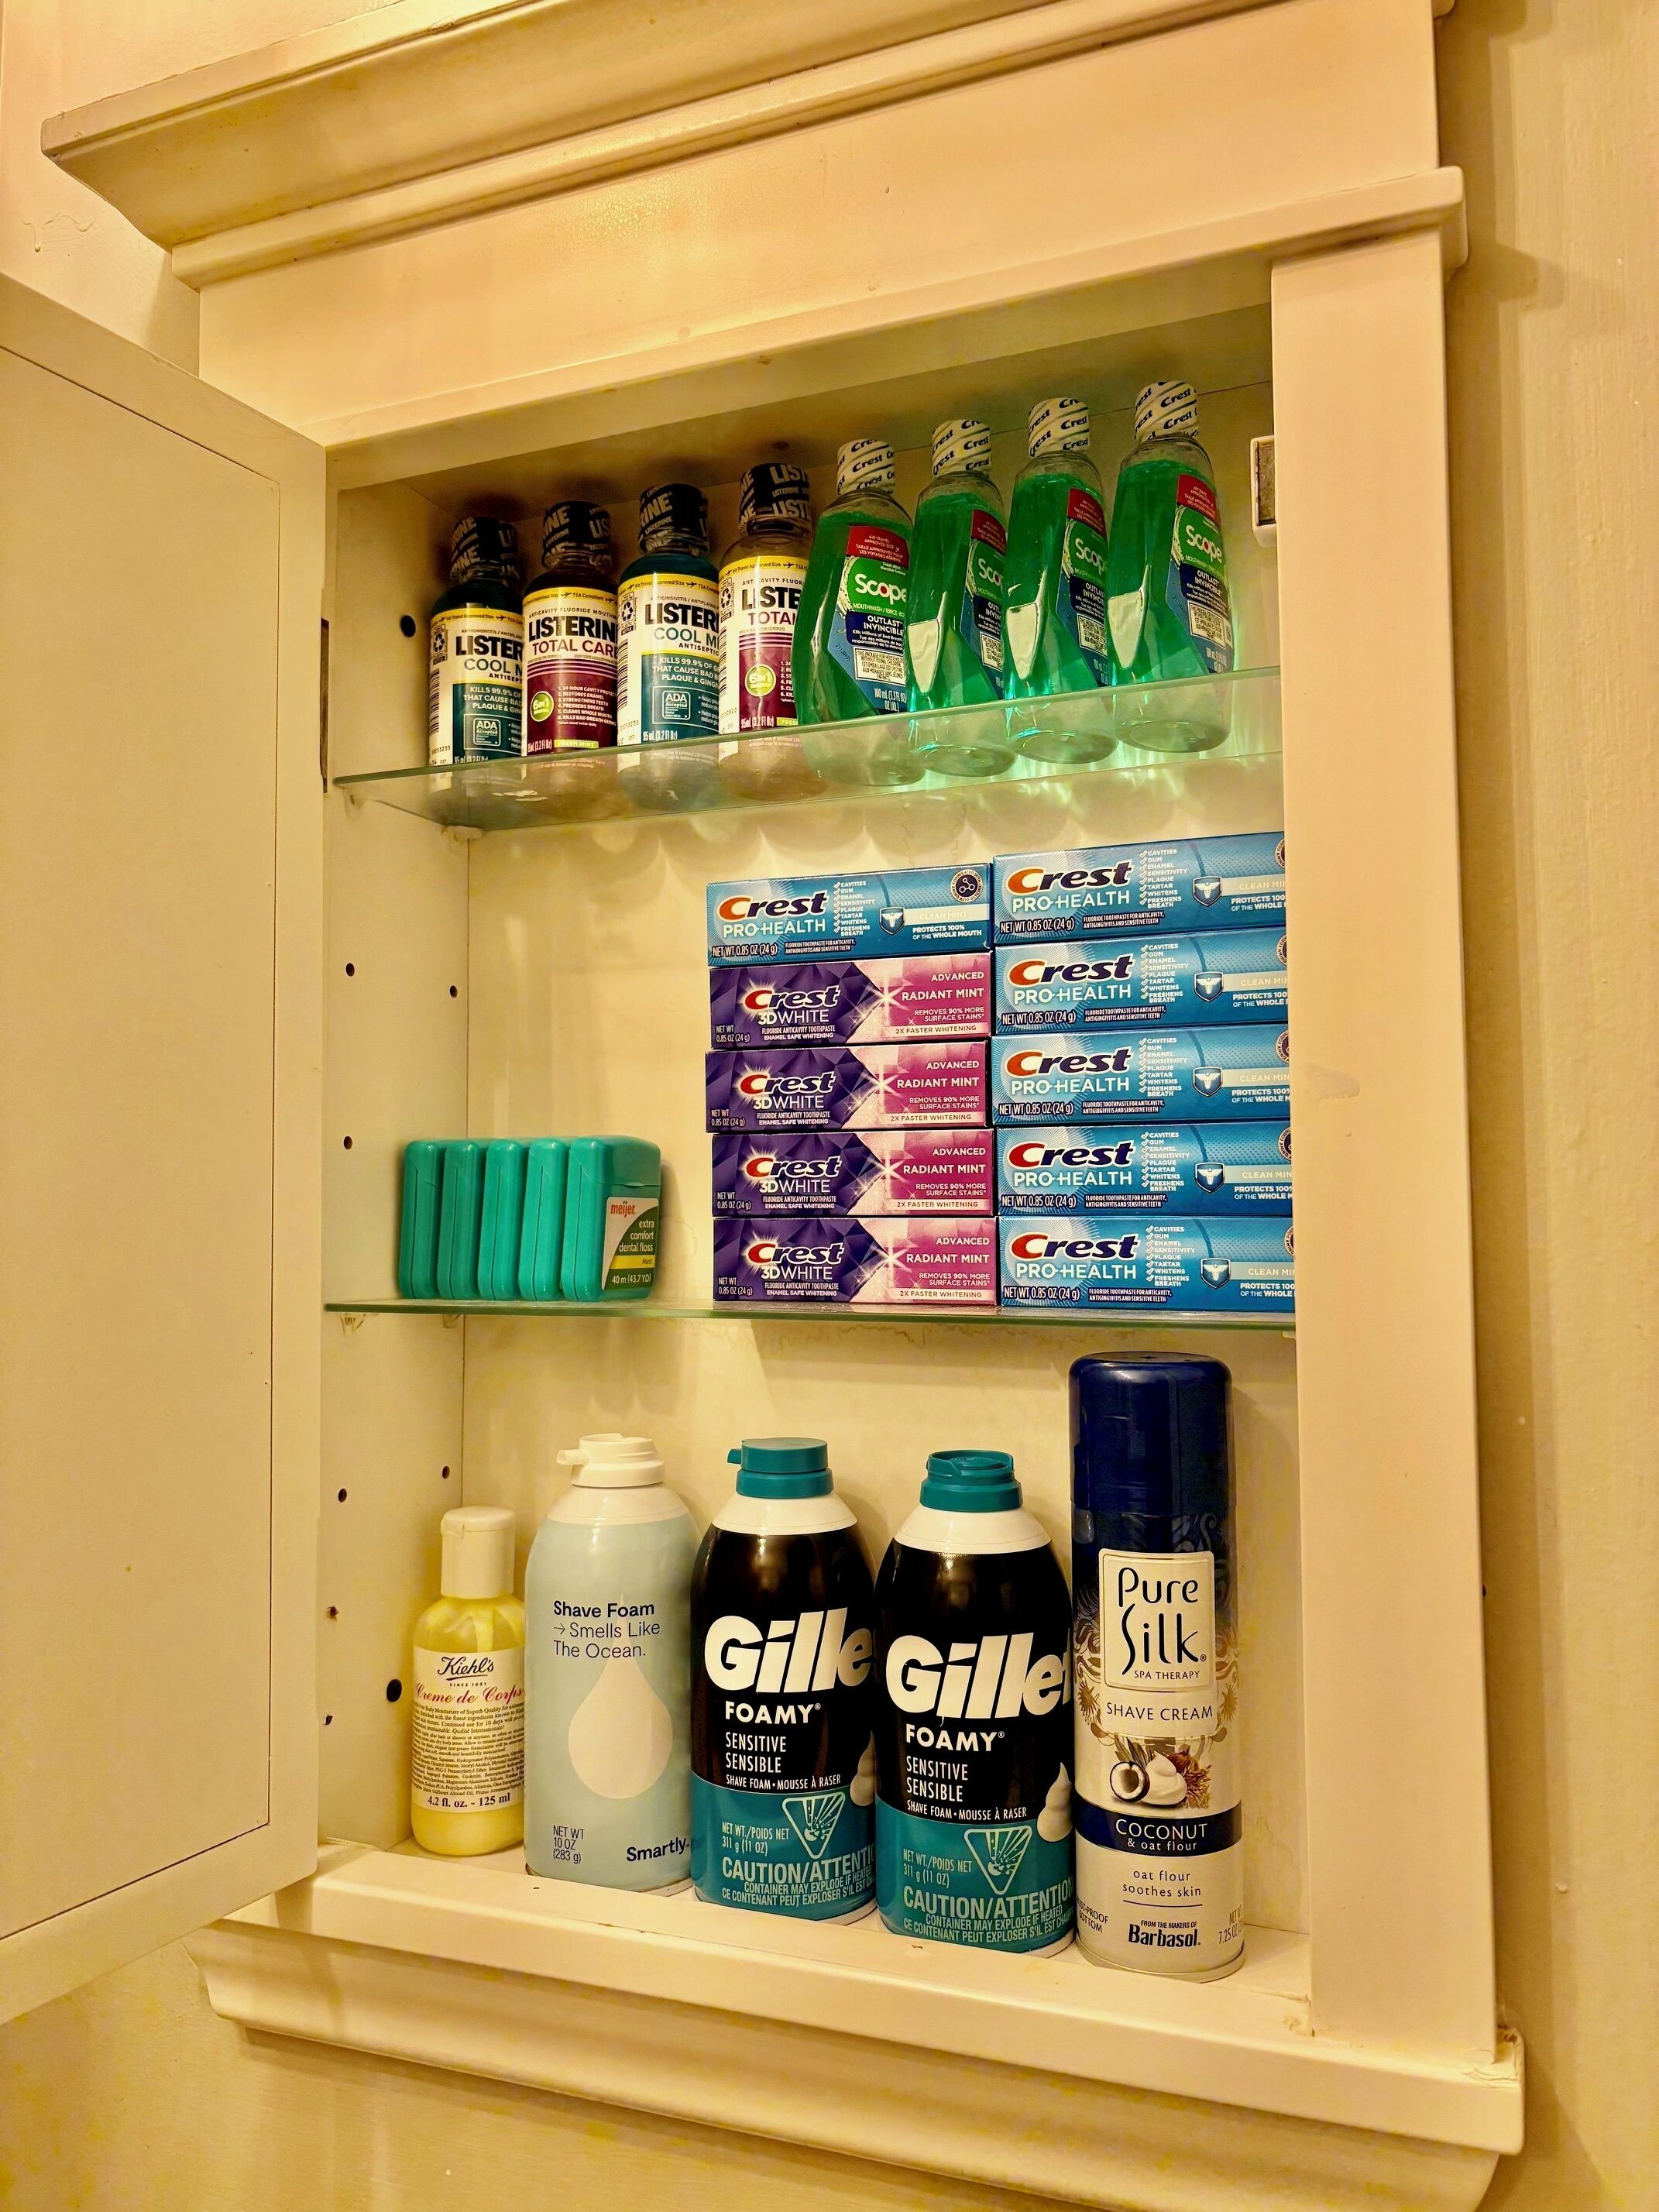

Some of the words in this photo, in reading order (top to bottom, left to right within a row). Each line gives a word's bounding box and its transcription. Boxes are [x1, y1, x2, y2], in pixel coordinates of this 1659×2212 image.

[1160, 388, 1190, 407] Crest
[1163, 411, 1192, 429] Crest
[853, 455, 882, 472] Crest
[1185, 525, 1222, 563] Scope
[654, 627, 702, 644] COOL
[532, 639, 578, 655] TOTAL
[465, 658, 511, 674] COOL
[681, 658, 702, 668] 99.9%
[665, 693, 687, 702] ADA
[1006, 860, 1135, 895] Crest
[717, 890, 829, 922] Crest
[713, 946, 724, 957] NET
[725, 946, 735, 957] WT
[736, 945, 749, 956] 0.85
[750, 944, 758, 955] OZ
[931, 972, 984, 982] ADVANCED
[1008, 953, 1135, 987] Crest
[744, 985, 840, 1011] Crest
[902, 990, 953, 1001] RADIANT
[957, 988, 984, 998] MINT
[1005, 1046, 1134, 1078] Crest
[740, 1071, 836, 1095] Crest
[897, 1078, 947, 1088] RADIANT
[951, 1077, 980, 1087] MINT
[1007, 1140, 1135, 1170] Crest
[745, 1156, 842, 1178] Crest
[903, 1165, 954, 1174] RADIANT
[958, 1164, 986, 1173] MINT
[639, 1220, 654, 1228] extra
[630, 1231, 654, 1240] comfort
[619, 1243, 638, 1252] dental
[639, 1242, 653, 1252] floss
[747, 1243, 844, 1265] Crest
[1009, 1234, 1140, 1261] Crest
[906, 1254, 957, 1263] RADIANT
[961, 1254, 990, 1263] MINT
[612, 1276, 620, 1284] 40
[627, 1274, 641, 1283] (43.7
[642, 1273, 651, 1283] YD)
[1118, 1567, 1198, 1607] Pure
[553, 1600, 602, 1618] Shave
[607, 1602, 655, 1617] Foam
[569, 1622, 622, 1638] Smells
[628, 1621, 661, 1637] Like
[1121, 1603, 1199, 1675] Silk
[553, 1640, 580, 1657] The
[586, 1643, 646, 1659] Ocean.
[438, 1657, 494, 1675] Kiehl's
[1134, 1671, 1152, 1679] SPA
[1156, 1670, 1200, 1680] THERAPY
[456, 1689, 478, 1703] de
[483, 1685, 524, 1705] Corps
[1107, 1702, 1154, 1720] SHAVE
[1160, 1705, 1213, 1721] CREAM
[726, 1732, 786, 1753] SENSITIVE
[726, 1752, 781, 1774] SENSIBLE
[906, 1755, 968, 1781] SENSITIVE
[726, 1774, 747, 1788] SHAVE
[750, 1777, 771, 1790] FOAM
[777, 1778, 809, 1791] MOUSSE
[812, 1775, 816, 1788] À
[819, 1774, 841, 1787] RASER
[906, 1777, 963, 1802] SENSIBLE
[428, 1795, 439, 1806] 4.2
[442, 1798, 451, 1807] fl.
[479, 1795, 496, 1806] 125
[499, 1793, 510, 1803] ml
[553, 1825, 568, 1838] NET
[570, 1828, 586, 1839] WT
[1115, 1819, 1207, 1840] COCONUT
[554, 1837, 562, 1848] 10
[565, 1839, 576, 1850] OZ
[626, 1836, 686, 1863] Smartly
[1128, 1838, 1135, 1847] &
[1141, 1842, 1161, 1850] oat
[1167, 1840, 1197, 1851] flour
[553, 1849, 571, 1862] (283
[573, 1852, 582, 1864] g)
[1133, 1870, 1153, 1880] oat
[1159, 1870, 1190, 1881] flour
[1123, 1884, 1172, 1898] soothes
[1177, 1886, 1201, 1898] skin
[926, 1914, 970, 1931] CONTAINER
[974, 1918, 992, 1931] MAY
[995, 1914, 1030, 1931] EXPLODE
[1032, 1911, 1039, 1925] IF
[1041, 1905, 1063, 1922] HEATED
